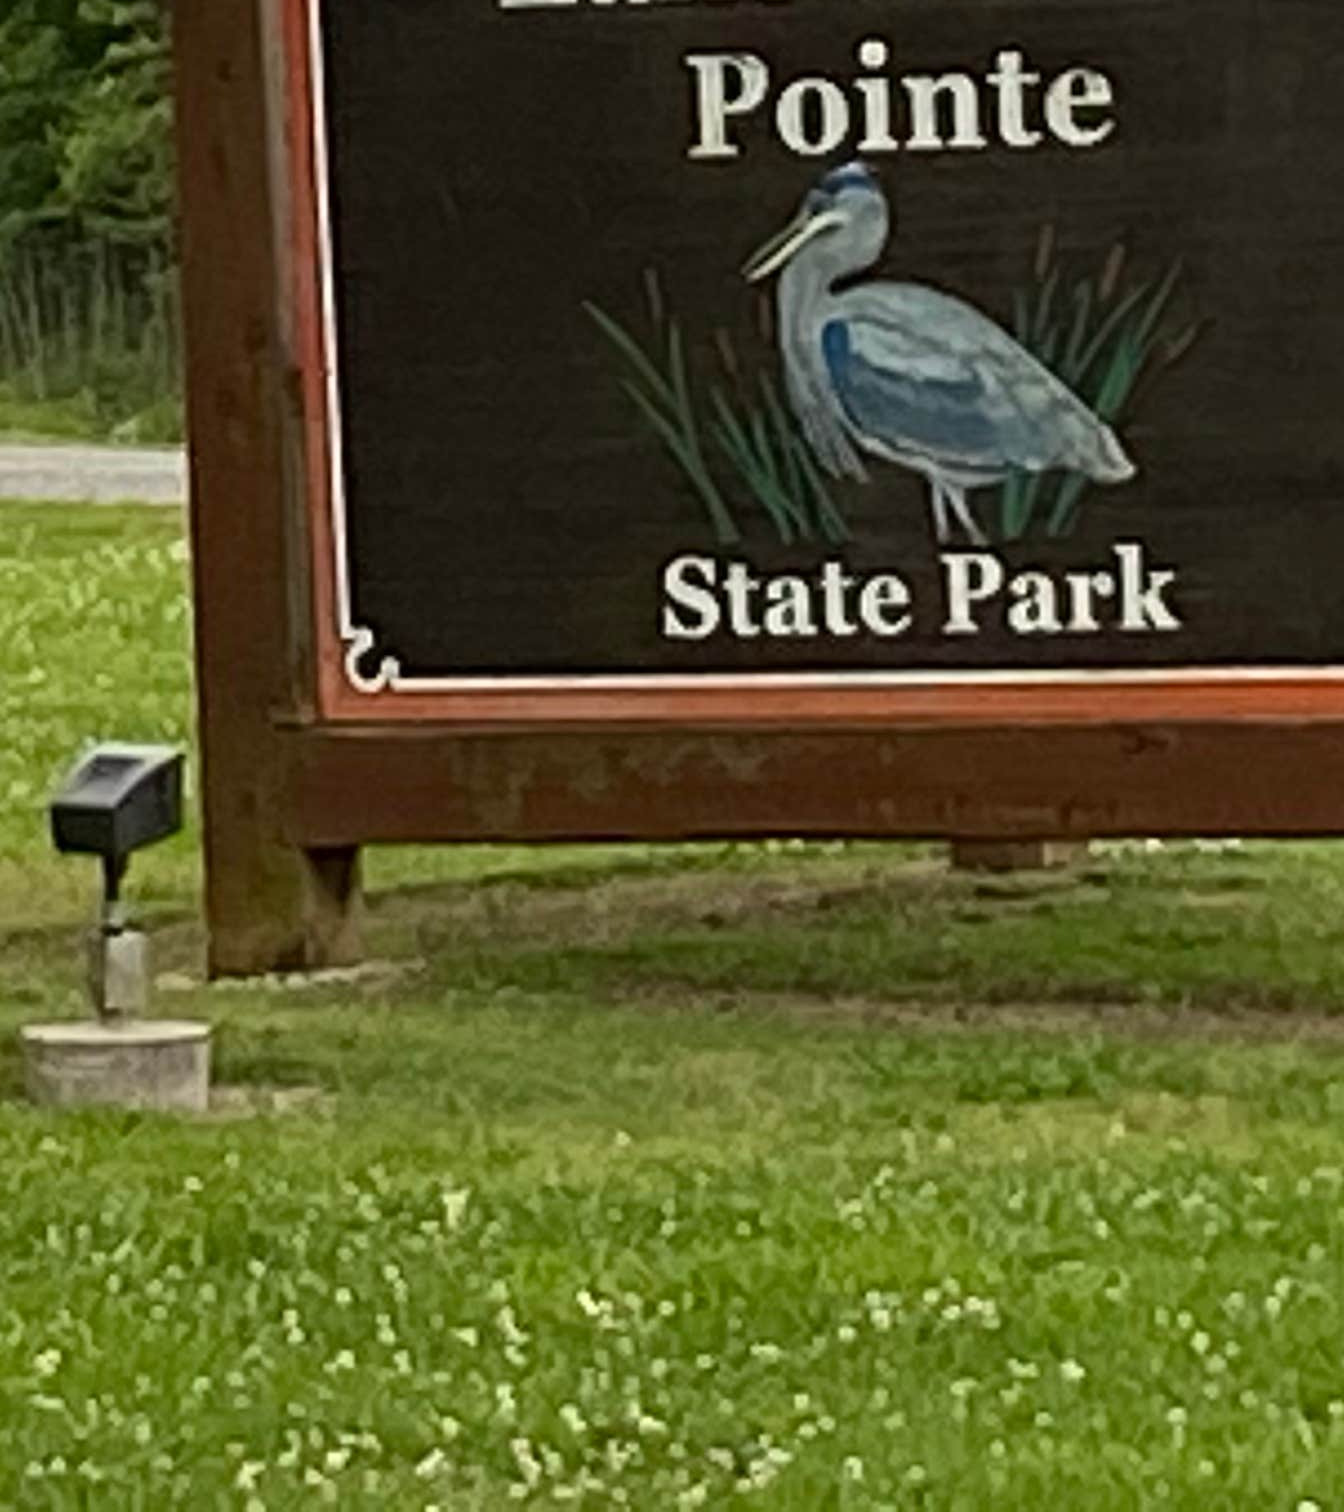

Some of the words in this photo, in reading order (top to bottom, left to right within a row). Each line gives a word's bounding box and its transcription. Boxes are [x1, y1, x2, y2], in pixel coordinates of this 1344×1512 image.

[686, 40, 1113, 157] Pointe
[663, 556, 912, 639] State
[940, 543, 1181, 634] Park
